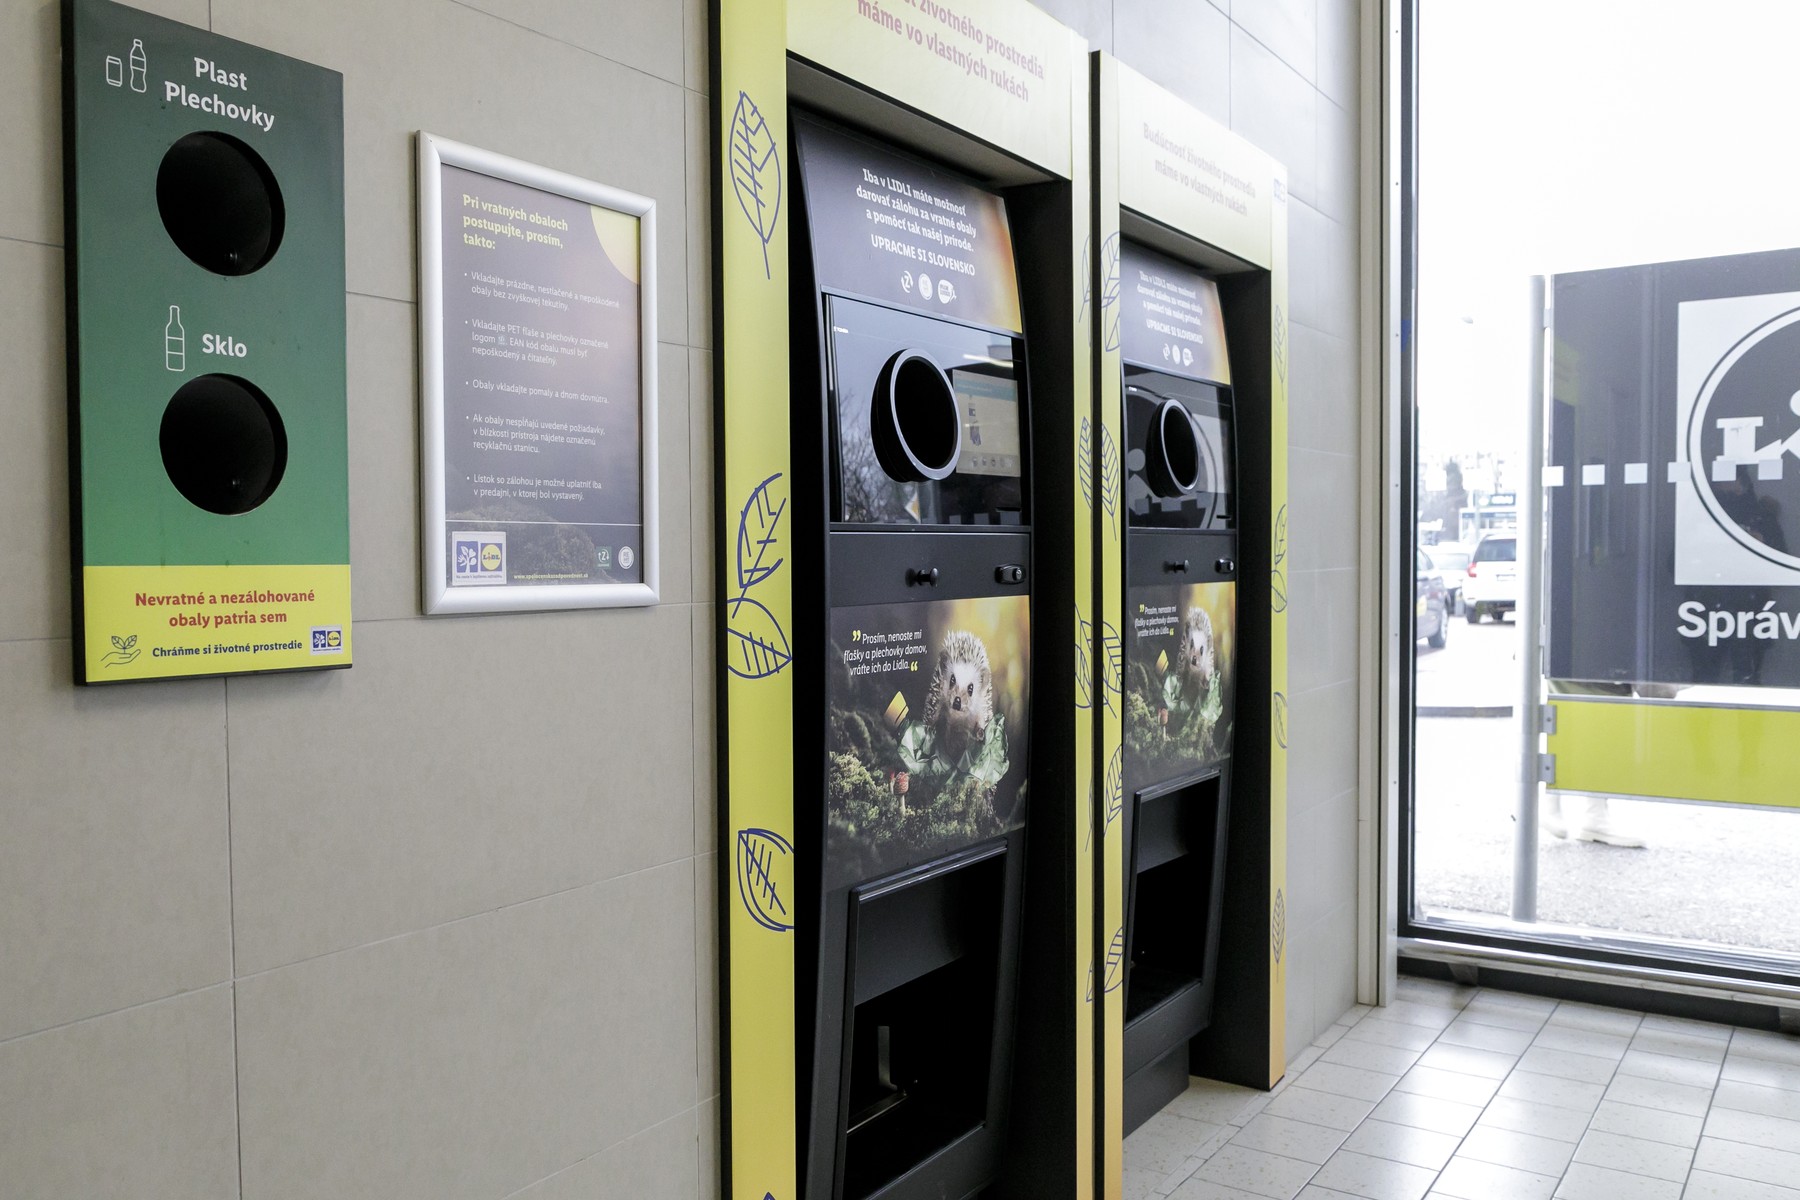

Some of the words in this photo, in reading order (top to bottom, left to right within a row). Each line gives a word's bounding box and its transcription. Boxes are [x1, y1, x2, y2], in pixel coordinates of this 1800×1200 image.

[858, 0, 902, 35] máme
[906, 22, 923, 45] vo
[926, 32, 987, 79] vlastných
[990, 68, 1029, 102] rukách
[986, 32, 1044, 80] prostredia
[194, 57, 247, 91] Plast
[165, 81, 275, 132] Plechovky
[862, 168, 879, 185] Iba
[880, 177, 886, 188] v
[887, 177, 911, 197] LIDLI
[912, 188, 933, 205] máte
[934, 196, 966, 216] možnosť
[462, 193, 479, 209] Pri
[481, 200, 527, 221] vratných
[529, 213, 568, 231] obaloch
[856, 185, 890, 208] darovať
[891, 197, 919, 216] zálohu
[920, 209, 929, 220] za
[930, 210, 955, 229] vratné
[956, 219, 976, 239] obaly
[462, 215, 524, 240] postupujte,
[526, 230, 563, 249] prosím,
[463, 233, 496, 249] takto:
[866, 210, 872, 219] a
[873, 210, 906, 232] pomôcť
[907, 221, 920, 235] tak
[922, 226, 943, 246] našej
[944, 233, 974, 252] prírode.
[871, 234, 916, 259] UPRACME
[917, 249, 927, 262] SI
[928, 253, 975, 276] SLOVENSKO
[471, 271, 504, 286] Vkladajte
[506, 278, 536, 292] prázdne,
[537, 283, 573, 300] nestlačené
[471, 285, 492, 297] obaly
[493, 289, 506, 299] bez
[507, 292, 541, 307] zvyškovej
[471, 318, 506, 333] Vkladajte
[507, 324, 520, 334] PET
[546, 329, 579, 346] plechovky
[471, 331, 496, 345] logom
[509, 337, 524, 348] EAN
[526, 339, 539, 351] kód
[540, 341, 559, 353] obalu
[202, 333, 247, 358] Sklo
[472, 345, 520, 361] nepoškodený
[472, 379, 495, 392] Obaly
[496, 383, 528, 396] vkladajte
[529, 386, 554, 399] pomaly
[560, 390, 579, 400] dnom
[473, 413, 483, 423] Ak
[484, 415, 504, 426] obaly
[540, 421, 568, 433] uvedené
[473, 428, 478, 436] v
[479, 428, 510, 439] blízkosti
[540, 432, 565, 444] nájdete
[566, 435, 596, 446] označenú
[473, 440, 512, 453] recyklačnú
[513, 443, 540, 454] stanicu.
[473, 474, 495, 484] Lístok
[496, 477, 505, 485] so
[506, 476, 534, 486] zálohou
[535, 478, 542, 488] je
[543, 478, 565, 487] možné
[566, 479, 591, 490] uplatniť
[592, 481, 602, 490] iba
[479, 487, 510, 499] predajni,
[518, 488, 538, 500] ktorej
[539, 490, 550, 499] bol
[551, 491, 585, 502] vystavený.
[135, 591, 205, 606] Nevratné
[208, 594, 217, 604] a
[220, 590, 315, 604] nezálohované
[169, 613, 210, 629] obaly
[214, 610, 257, 628] patria
[260, 612, 287, 624] sem
[1677, 600, 1800, 647] Správ
[888, 631, 913, 642] nenoste
[914, 629, 922, 640] mi
[152, 644, 200, 657] Chráňme
[202, 644, 211, 655] si
[213, 643, 251, 656] životné
[253, 640, 303, 653] prostredie
[843, 649, 864, 664] fľašky
[865, 651, 871, 659] a
[871, 645, 904, 662] plechovky
[904, 644, 928, 655] domov,
[850, 663, 870, 676] vráťte
[871, 662, 881, 674] ich
[882, 661, 891, 672] do
